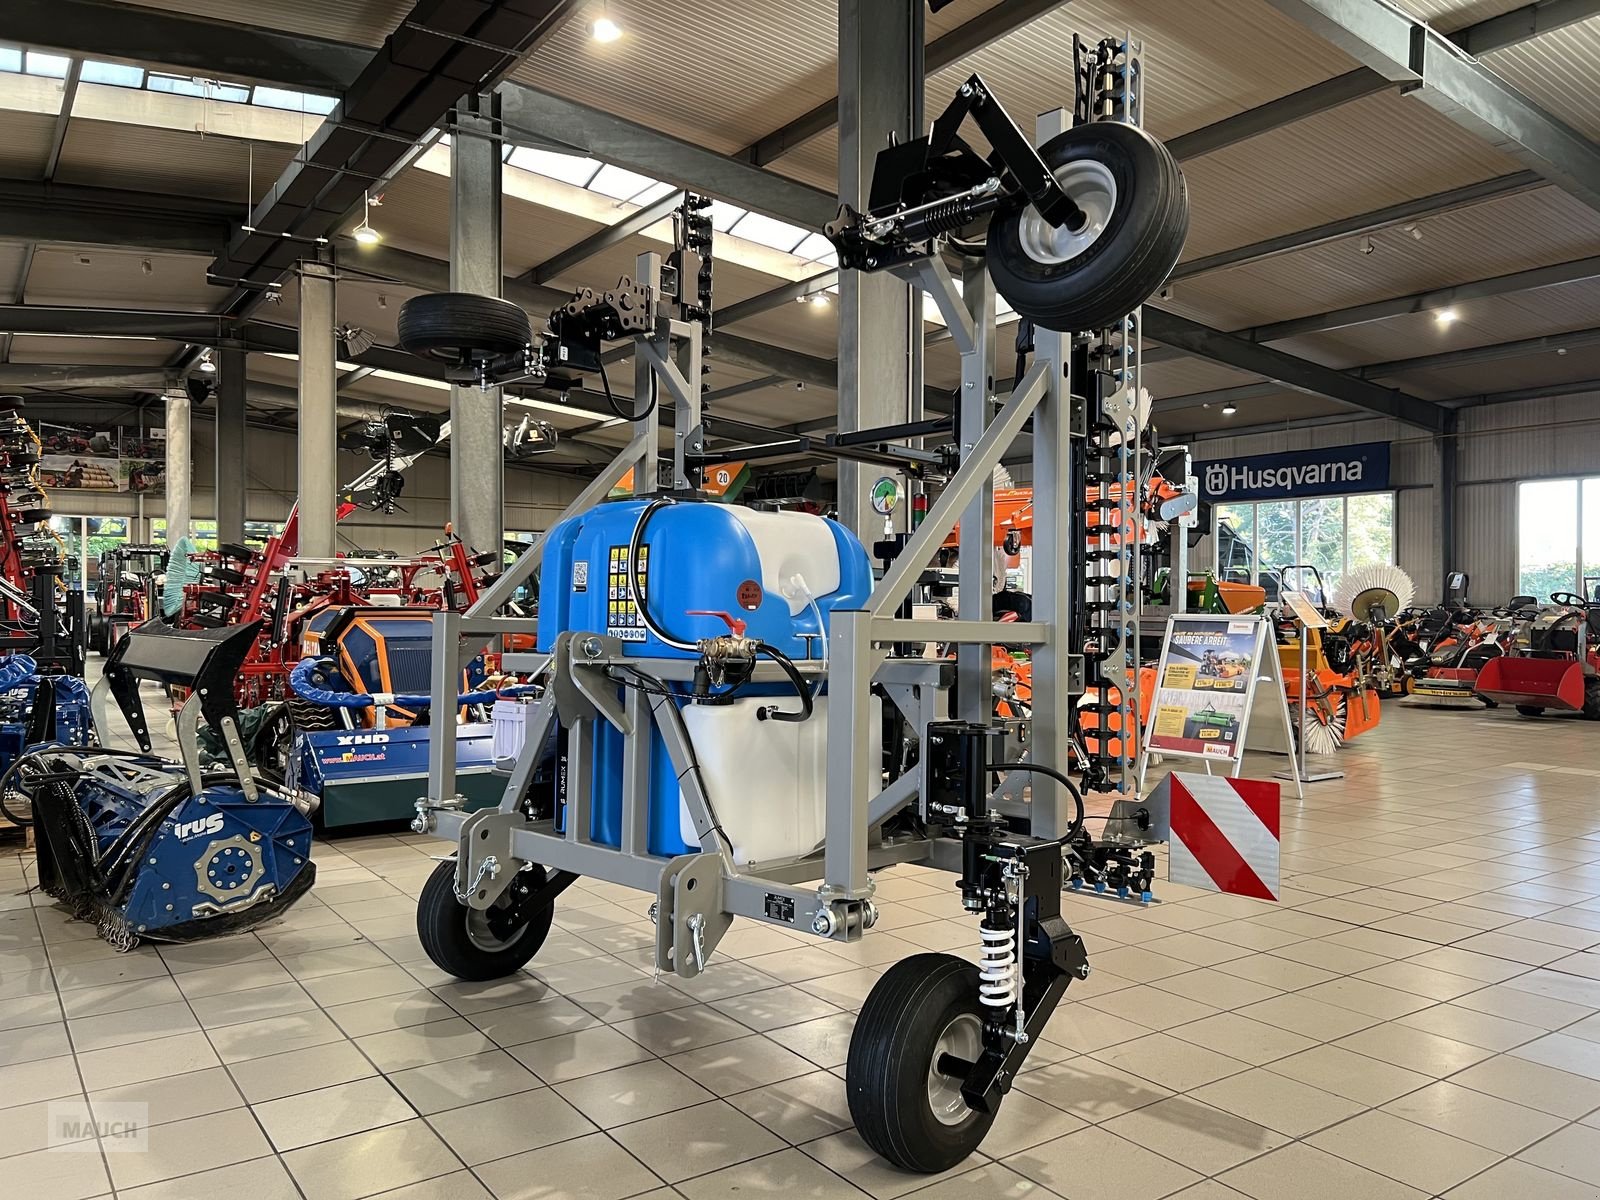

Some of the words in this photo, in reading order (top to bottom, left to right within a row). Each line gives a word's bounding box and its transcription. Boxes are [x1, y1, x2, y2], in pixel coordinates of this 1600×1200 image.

[719, 472, 728, 483] 20
[1231, 460, 1363, 490] Husqvarna
[1174, 635, 1202, 645] SAUBERE
[1203, 636, 1228, 646] ARBEIT
[336, 734, 390, 746] XHD
[1206, 745, 1228, 755] MAUCH
